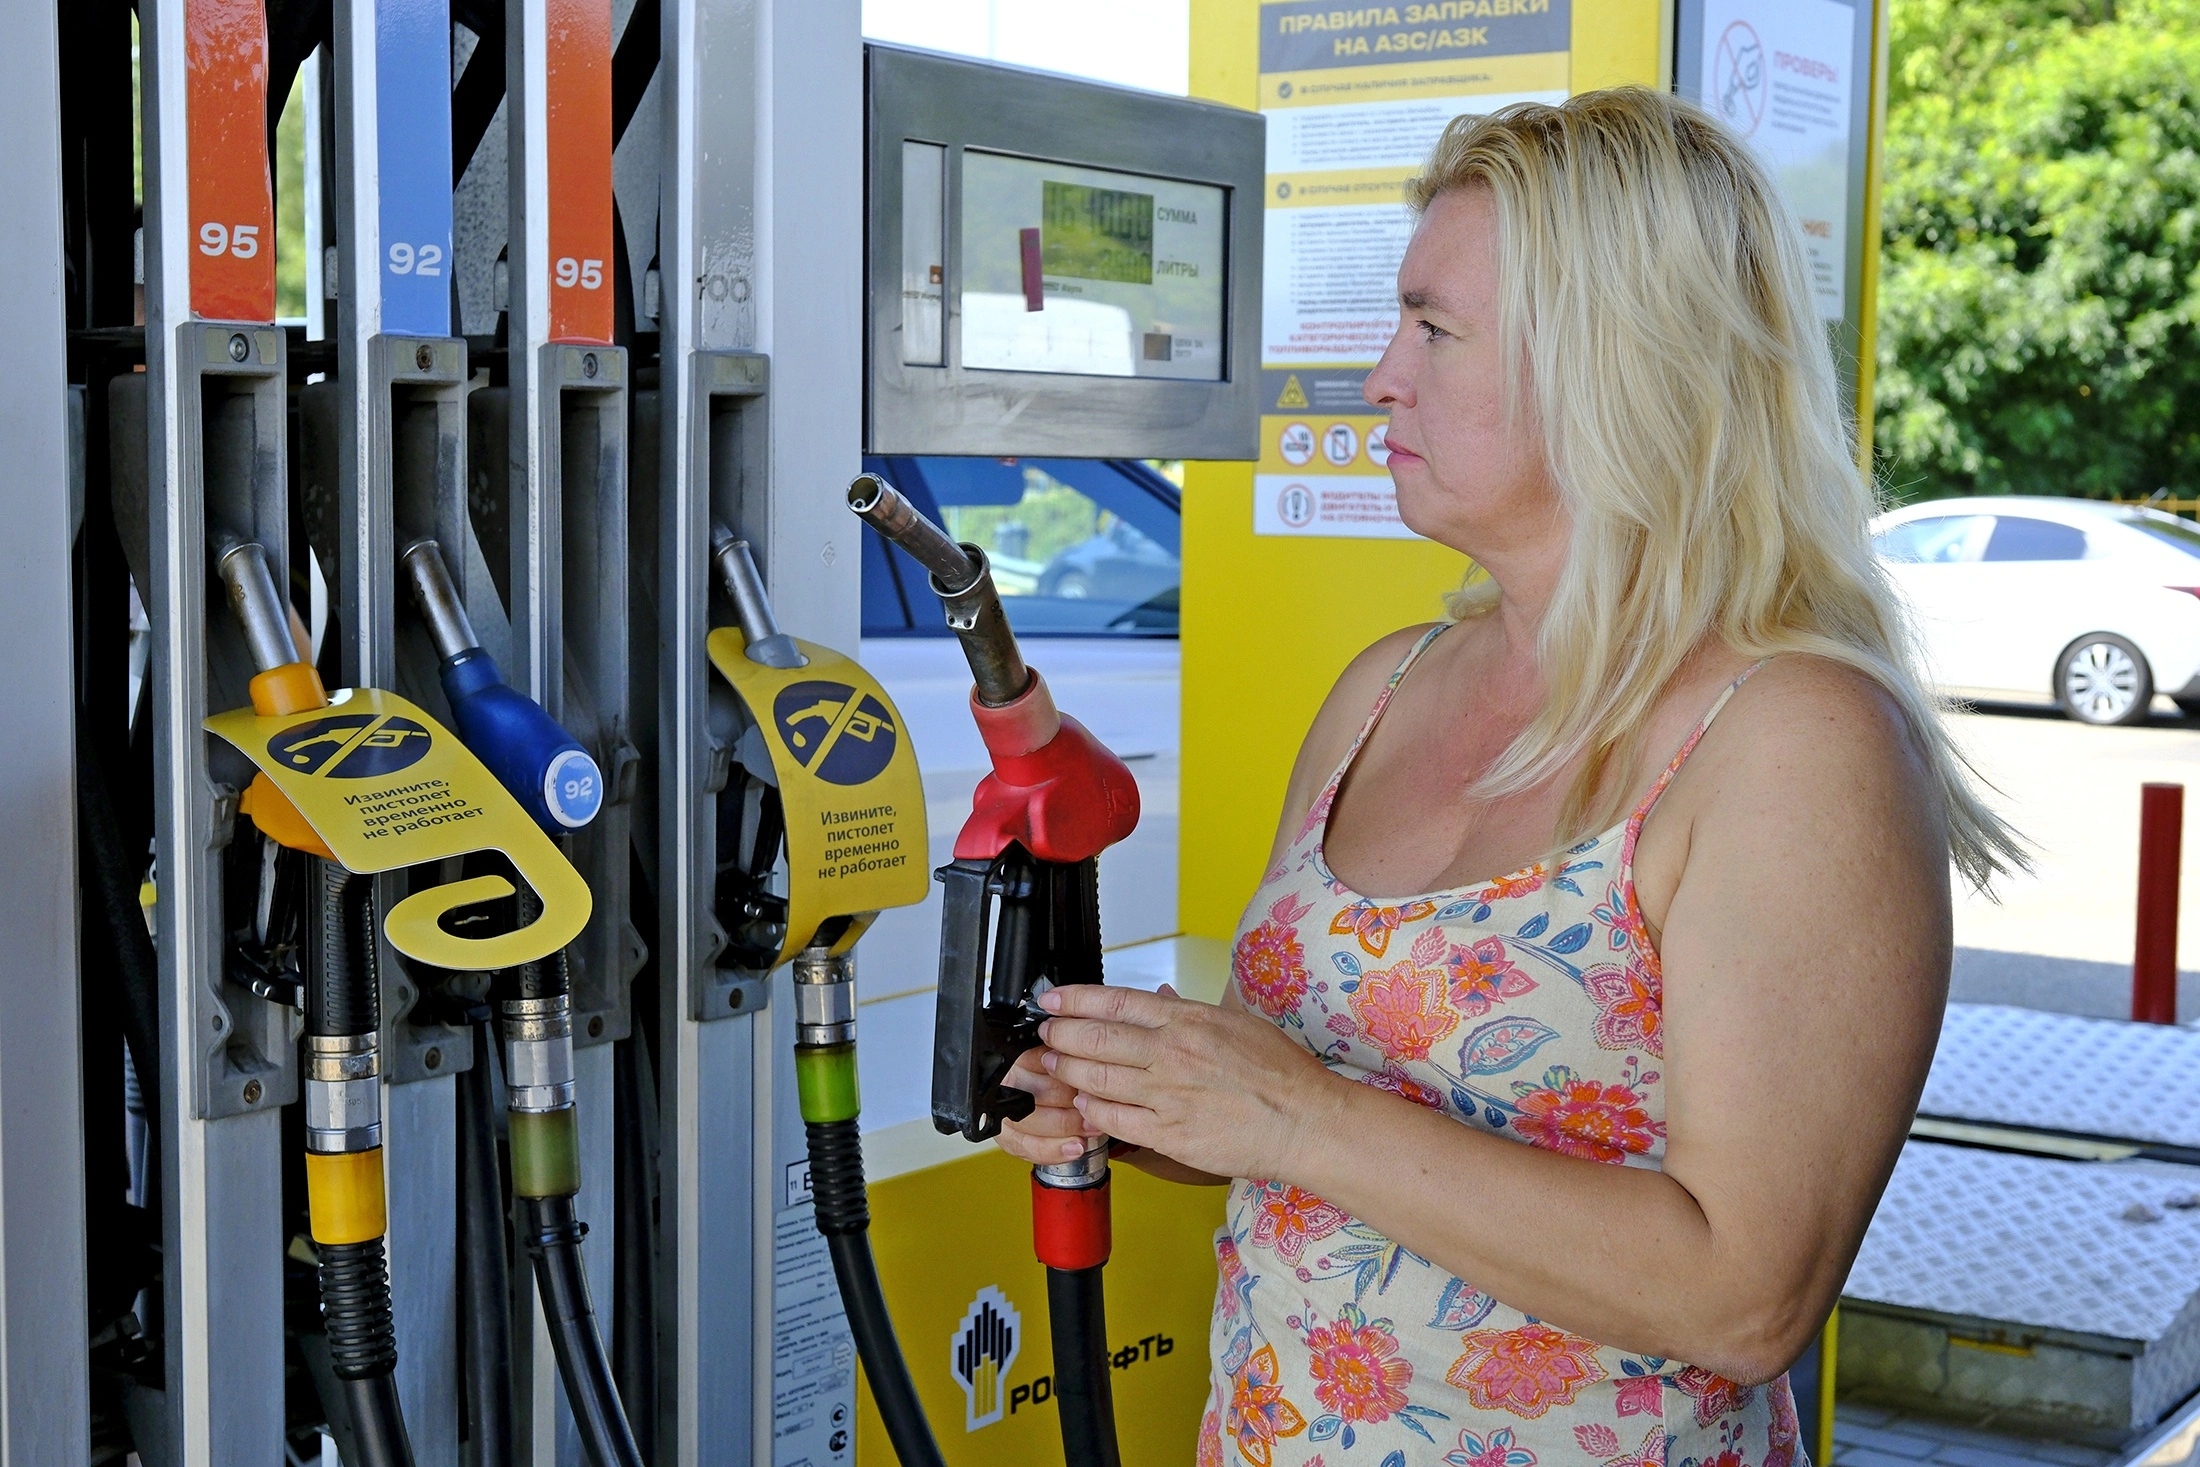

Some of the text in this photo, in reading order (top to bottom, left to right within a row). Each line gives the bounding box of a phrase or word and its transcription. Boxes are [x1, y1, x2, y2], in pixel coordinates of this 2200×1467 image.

[1279, 0, 1551, 35] ПРАВИЛА ЗАПРАВКИ
[1333, 26, 1490, 57] НА АЗС/АЗК
[1156, 206, 1198, 225] СУММА
[198, 222, 259, 260] 95
[388, 242, 442, 277] 92
[555, 257, 603, 290] 95
[1156, 260, 1199, 278] ЛИТРЫ
[343, 777, 450, 807] Извините,
[359, 787, 452, 816] пистолет
[564, 775, 594, 801] 92
[362, 805, 485, 841] не работает
[363, 798, 467, 828] временно
[821, 805, 897, 826] Извините,
[827, 821, 895, 843] пистолет
[824, 838, 900, 862] временно
[818, 855, 907, 879] не работает
[1010, 1333, 1174, 1415] РОФТЬ
